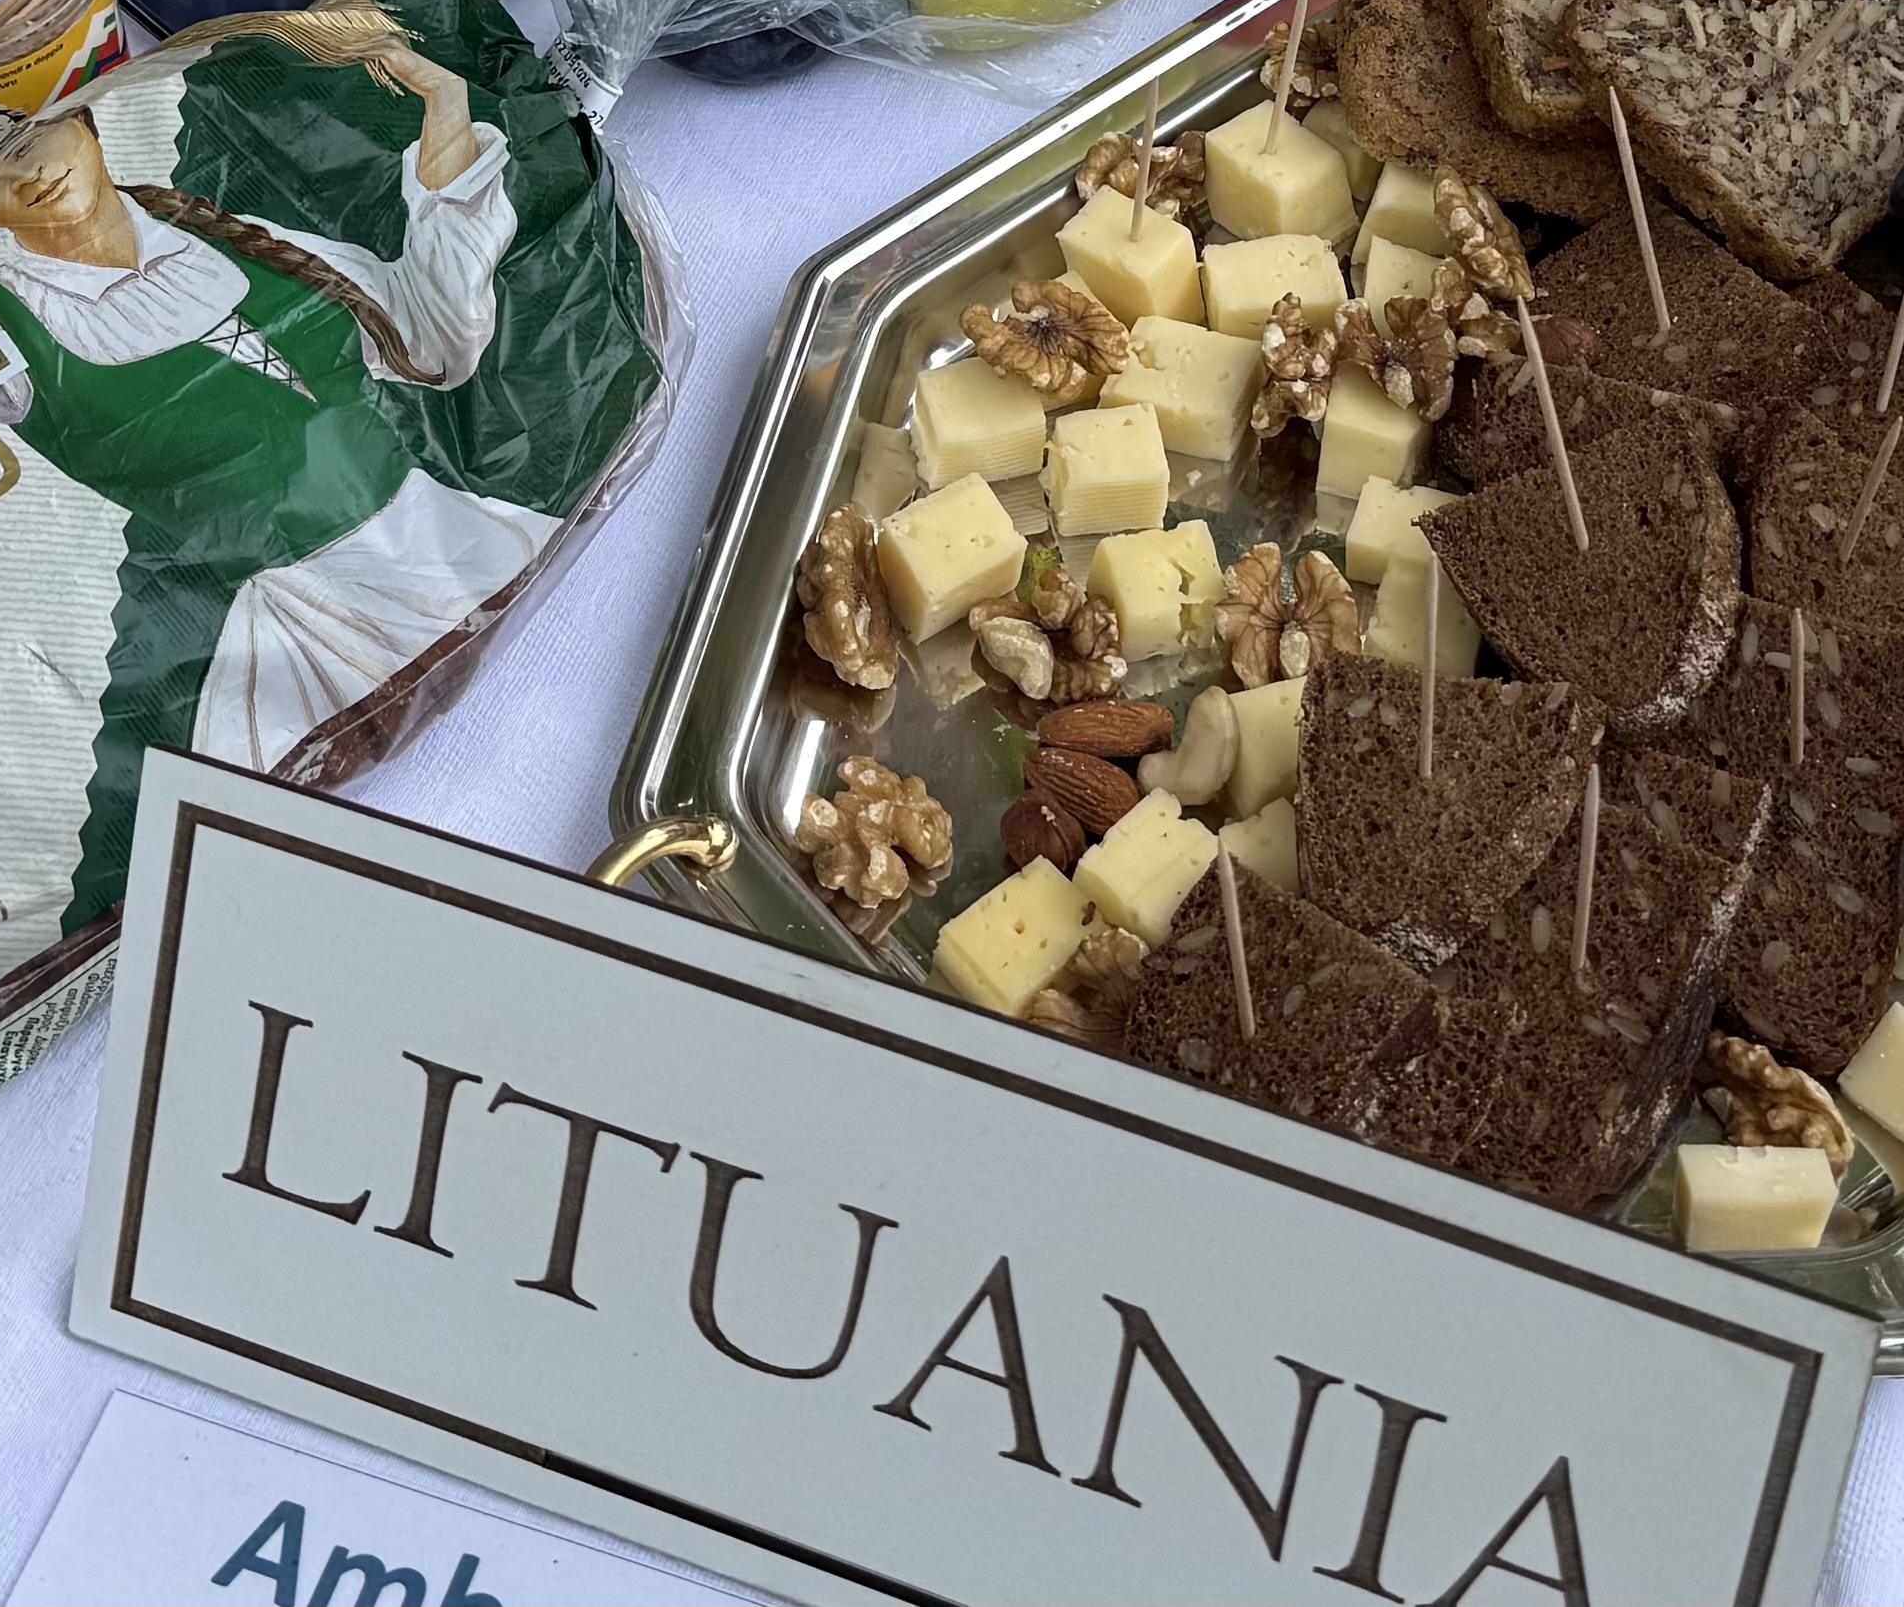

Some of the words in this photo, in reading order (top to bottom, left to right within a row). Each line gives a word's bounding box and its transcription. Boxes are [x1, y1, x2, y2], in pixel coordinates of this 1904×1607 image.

[25, 62, 33, 71] a
[32, 42, 65, 66] doppia
[221, 1000, 1593, 1606] LITUANIA
